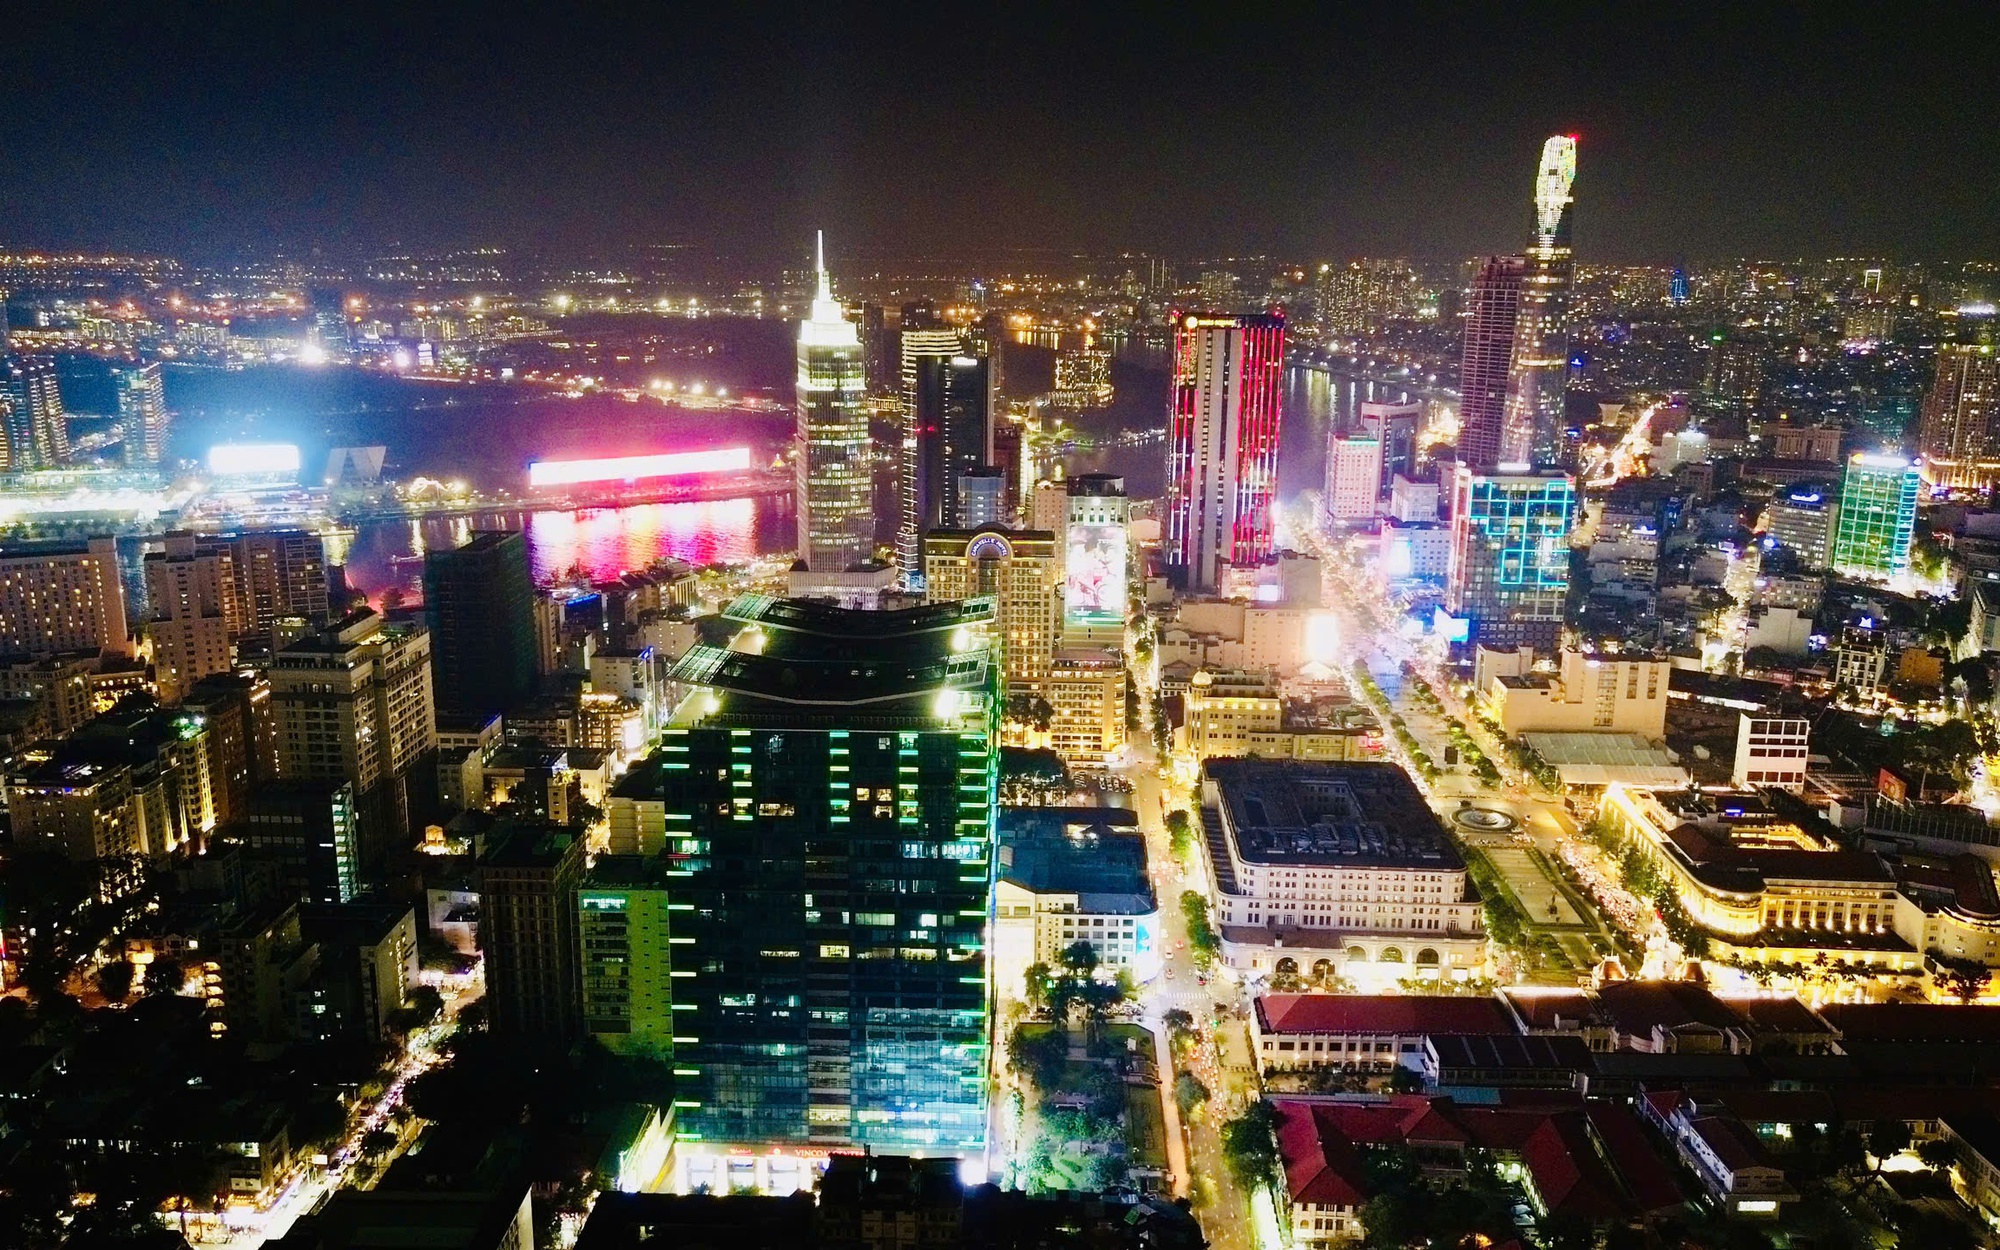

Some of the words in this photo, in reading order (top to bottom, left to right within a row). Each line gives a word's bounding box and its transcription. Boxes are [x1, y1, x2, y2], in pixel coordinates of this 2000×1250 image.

[971, 538, 996, 557] CARAVELLE
[995, 540, 1008, 557] HOTEL
[794, 1149, 831, 1157] VINCOM
